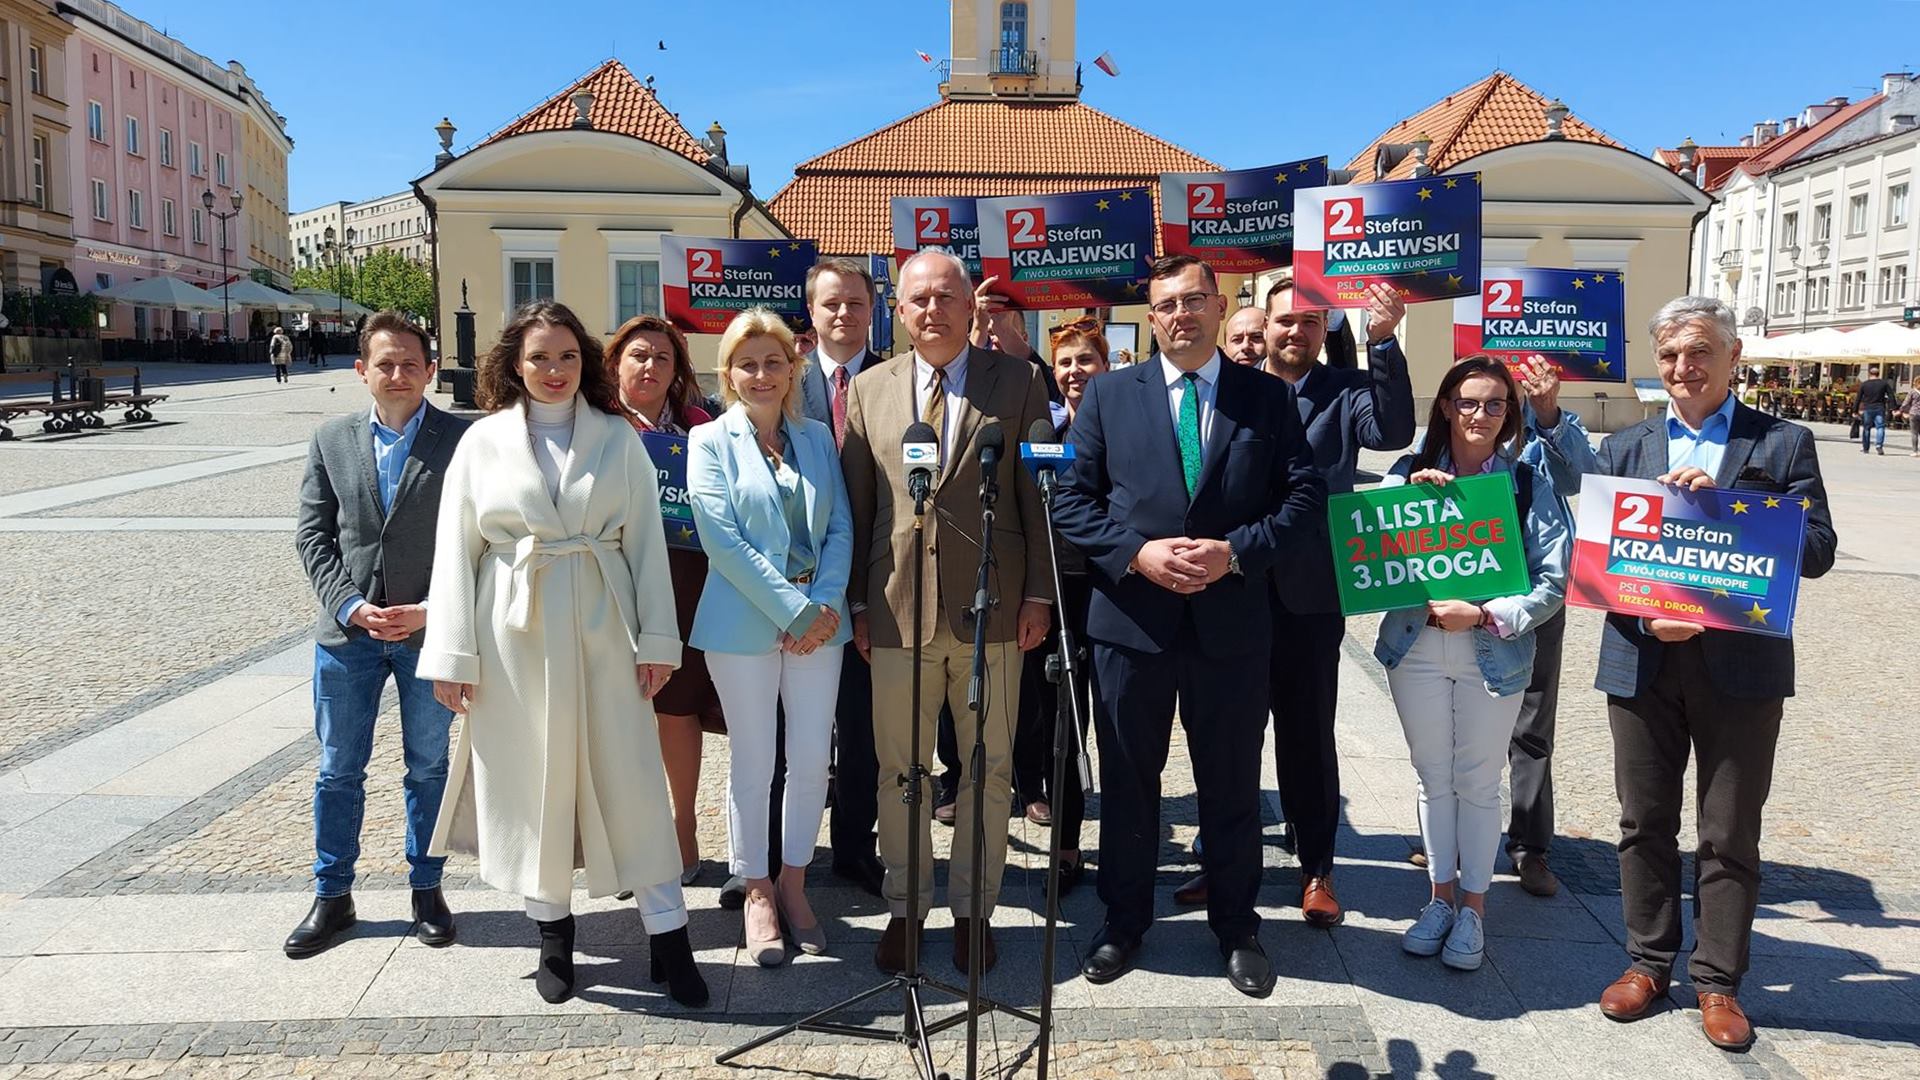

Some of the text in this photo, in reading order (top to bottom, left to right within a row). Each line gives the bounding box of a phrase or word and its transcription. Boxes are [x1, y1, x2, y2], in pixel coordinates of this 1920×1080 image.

[1192, 186, 1278, 214] 2. Stefan
[920, 210, 979, 239] 2. Stef
[1012, 211, 1101, 243] 2. Stefan
[1191, 214, 1294, 235] KRAJEWS
[1329, 201, 1422, 236] 2. Stefan
[1012, 243, 1136, 267] KRAJEWSKI
[1327, 233, 1460, 261] KRAJEWSKI
[691, 251, 773, 281] 2. Stefan
[1024, 271, 1049, 279] TWÓJ
[1051, 269, 1073, 277] GŁOS
[1085, 266, 1120, 275] EUROPIE
[1338, 257, 1442, 273] TWÓJ GŁOS W EUROPIE
[691, 283, 801, 299] KRAJEWSKI
[1337, 281, 1354, 290] PSL
[1337, 291, 1365, 300] TRZEC
[702, 300, 724, 308] TWÓJ
[1488, 282, 1576, 315] 2. Stefan
[1485, 320, 1607, 337] KRAJEWSKI
[1496, 338, 1521, 347] TWÓJ
[1522, 339, 1546, 347] GŁOS
[1559, 341, 1592, 349] EUROPIE
[661, 506, 679, 515] OPIE
[1351, 497, 1464, 534] 1. LISTA
[1618, 495, 1732, 545] 2. Stefan
[1346, 518, 1506, 562] 2. MIEJSCE
[1352, 549, 1501, 590] 3. DROGA
[1612, 538, 1775, 577] KRAJEWSKI
[1619, 582, 1638, 593] PSL
[1622, 563, 1749, 590] TWÓJ GŁOS W EUROPIE
[1619, 594, 1704, 614] TRZECIA DROGA
